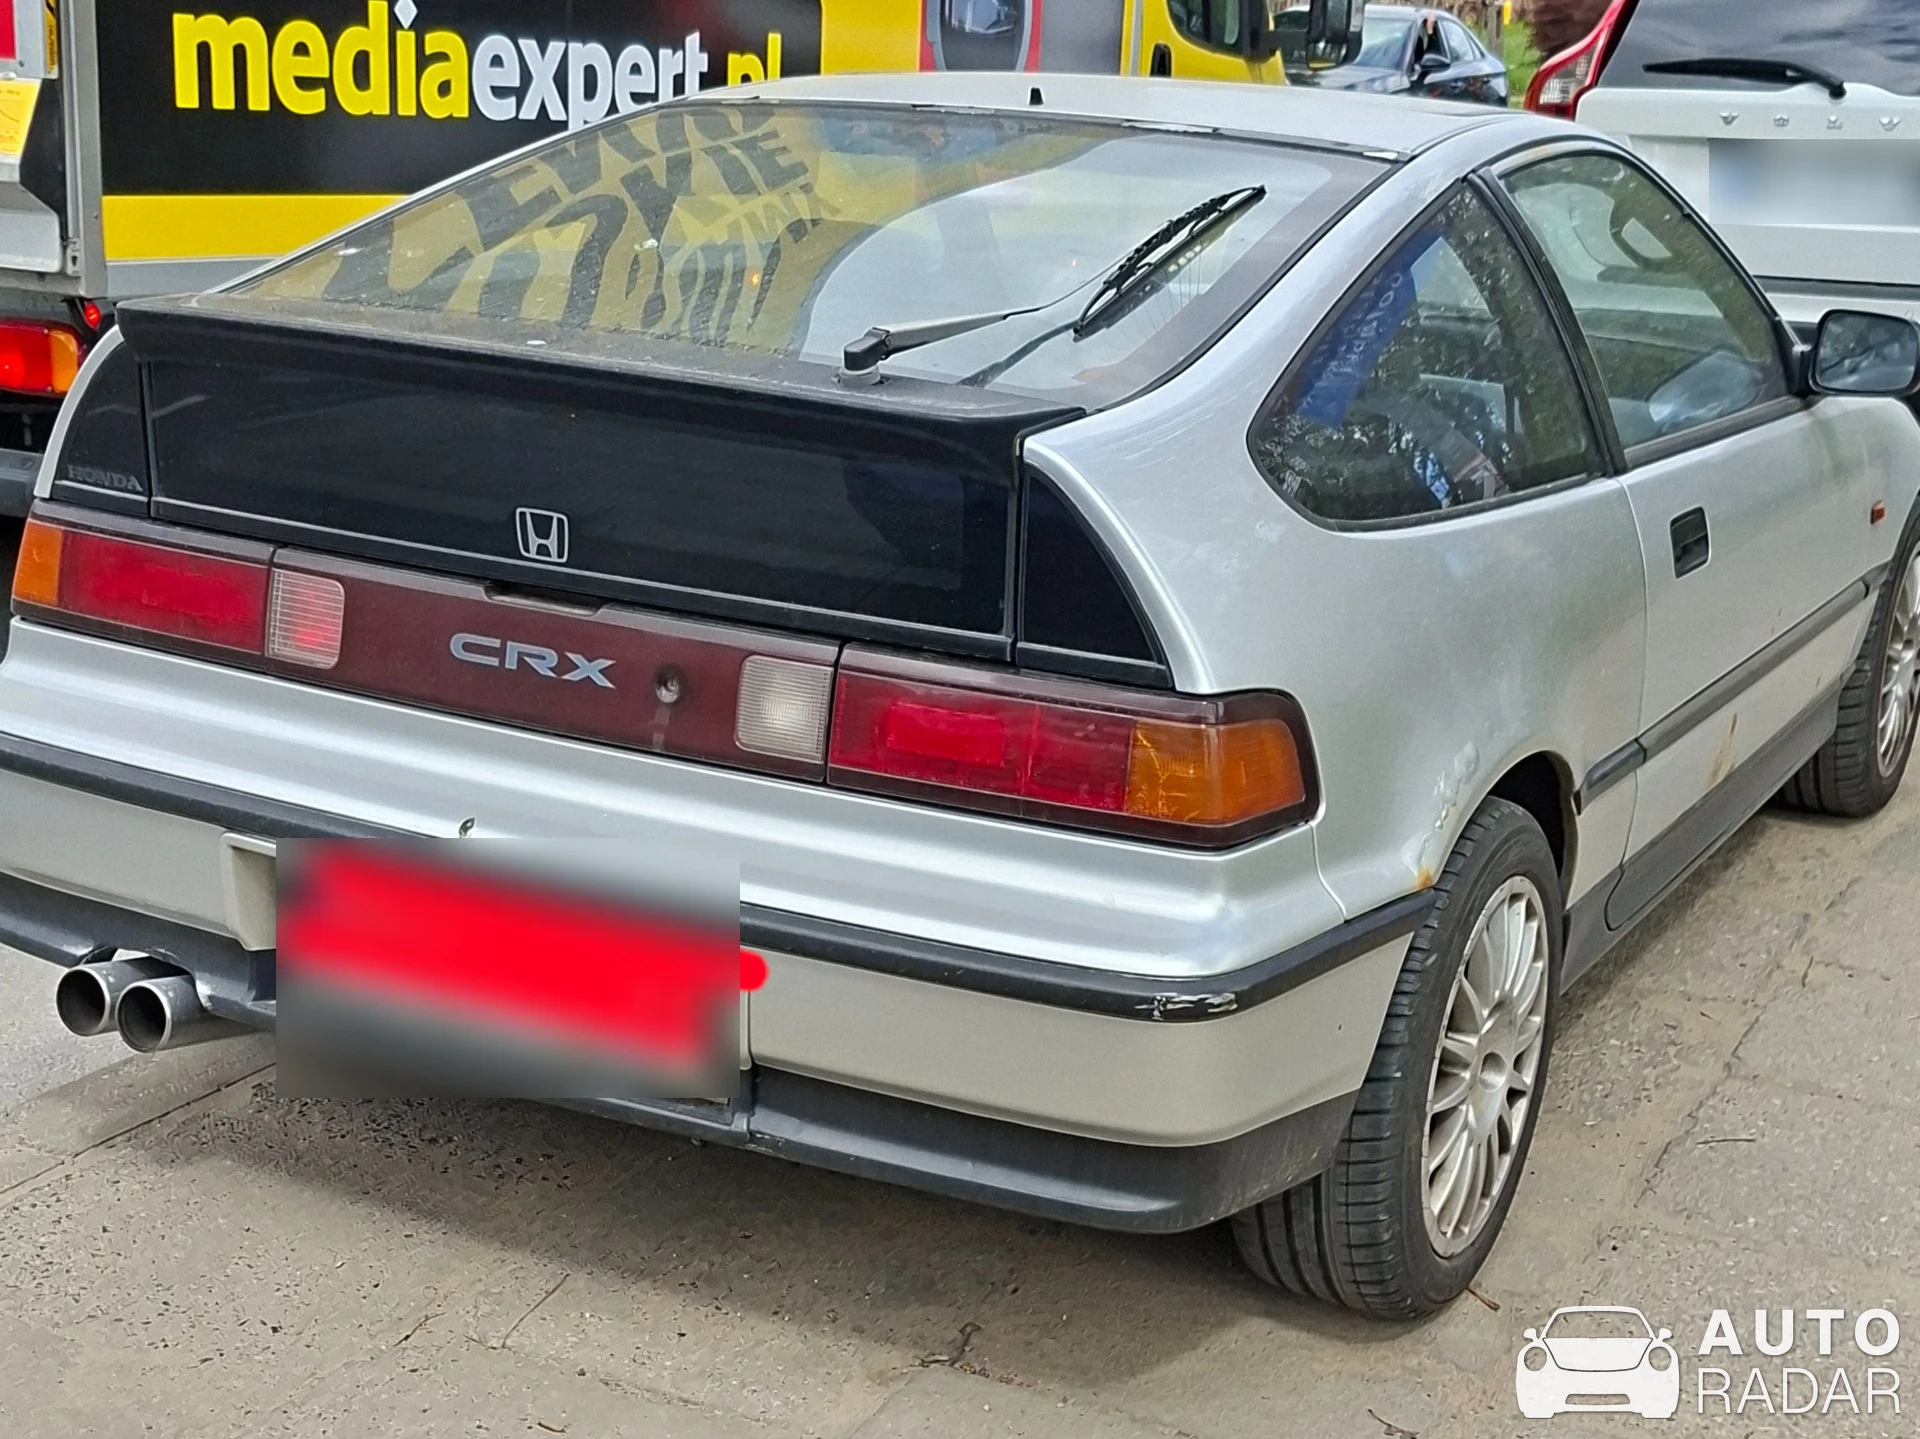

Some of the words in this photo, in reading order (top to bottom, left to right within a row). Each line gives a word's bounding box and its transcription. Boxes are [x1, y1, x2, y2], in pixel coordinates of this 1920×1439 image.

[172, 0, 783, 132] mediaexpertl
[66, 464, 144, 492] HONDA
[449, 632, 617, 690] CRX
